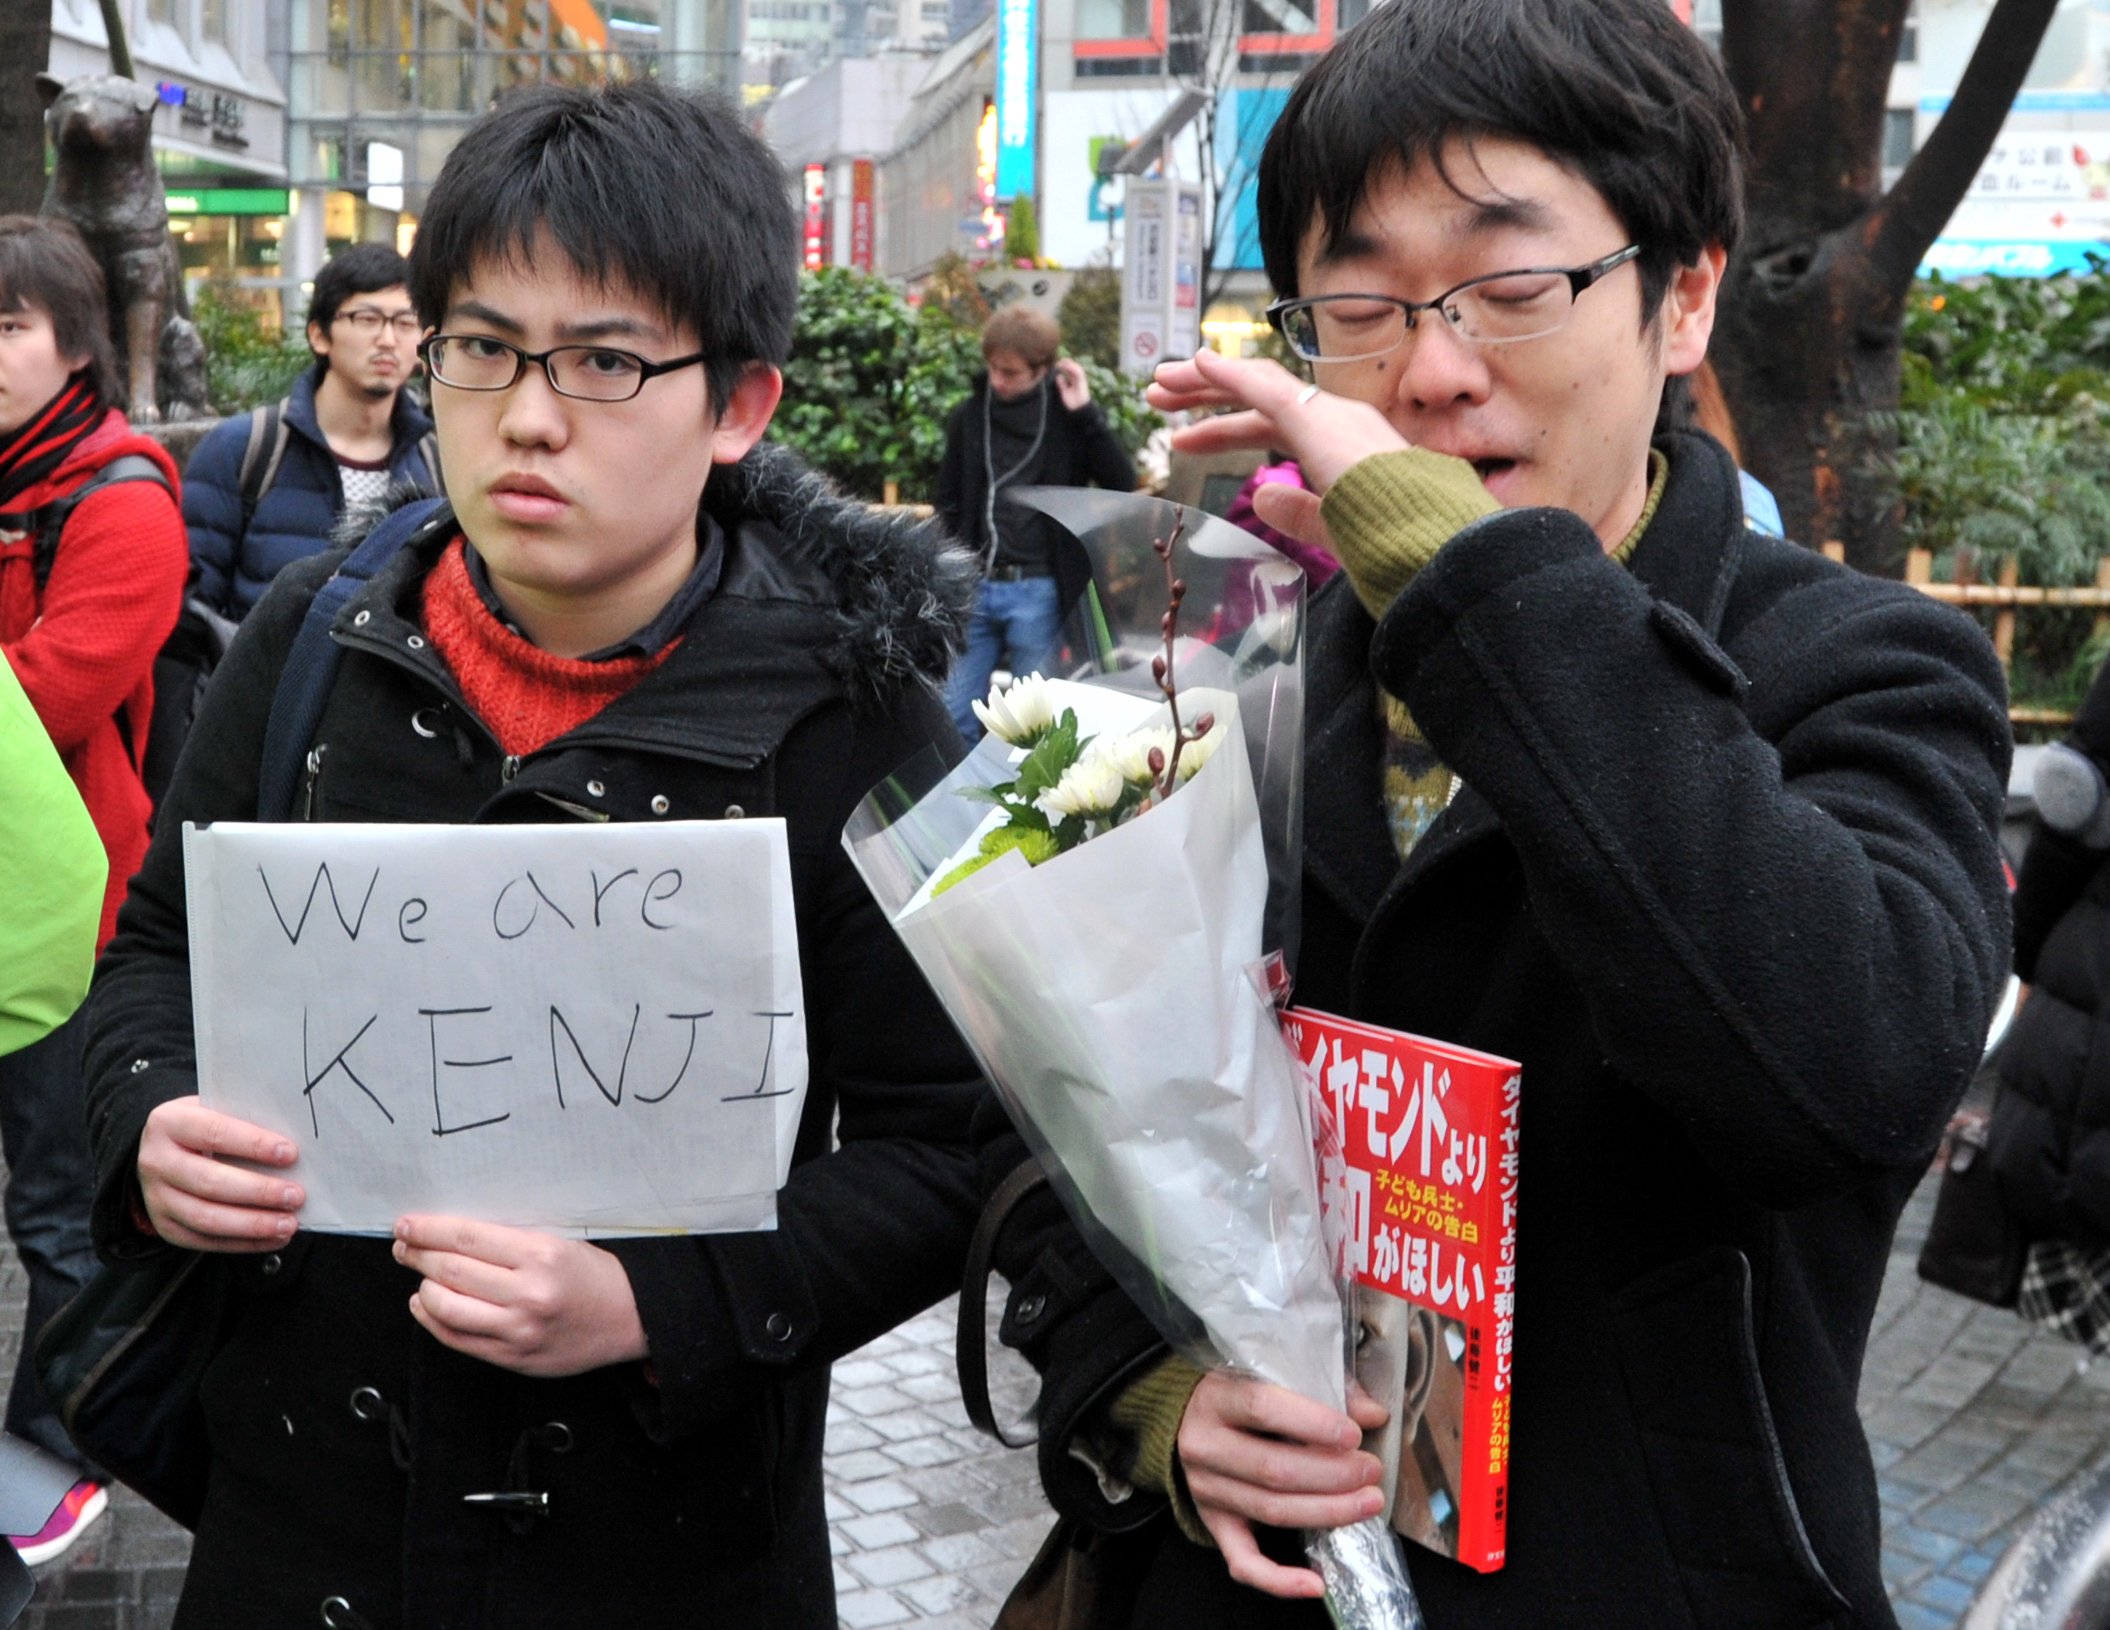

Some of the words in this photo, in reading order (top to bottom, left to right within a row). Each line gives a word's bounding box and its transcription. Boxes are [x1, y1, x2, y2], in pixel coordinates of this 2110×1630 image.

[258, 861, 427, 946] We
[493, 868, 682, 939] are
[302, 1003, 795, 1138] KENJI
[1284, 1022, 1487, 1194] イヤモンドより
[1384, 1196, 1479, 1244] ムリアの告白
